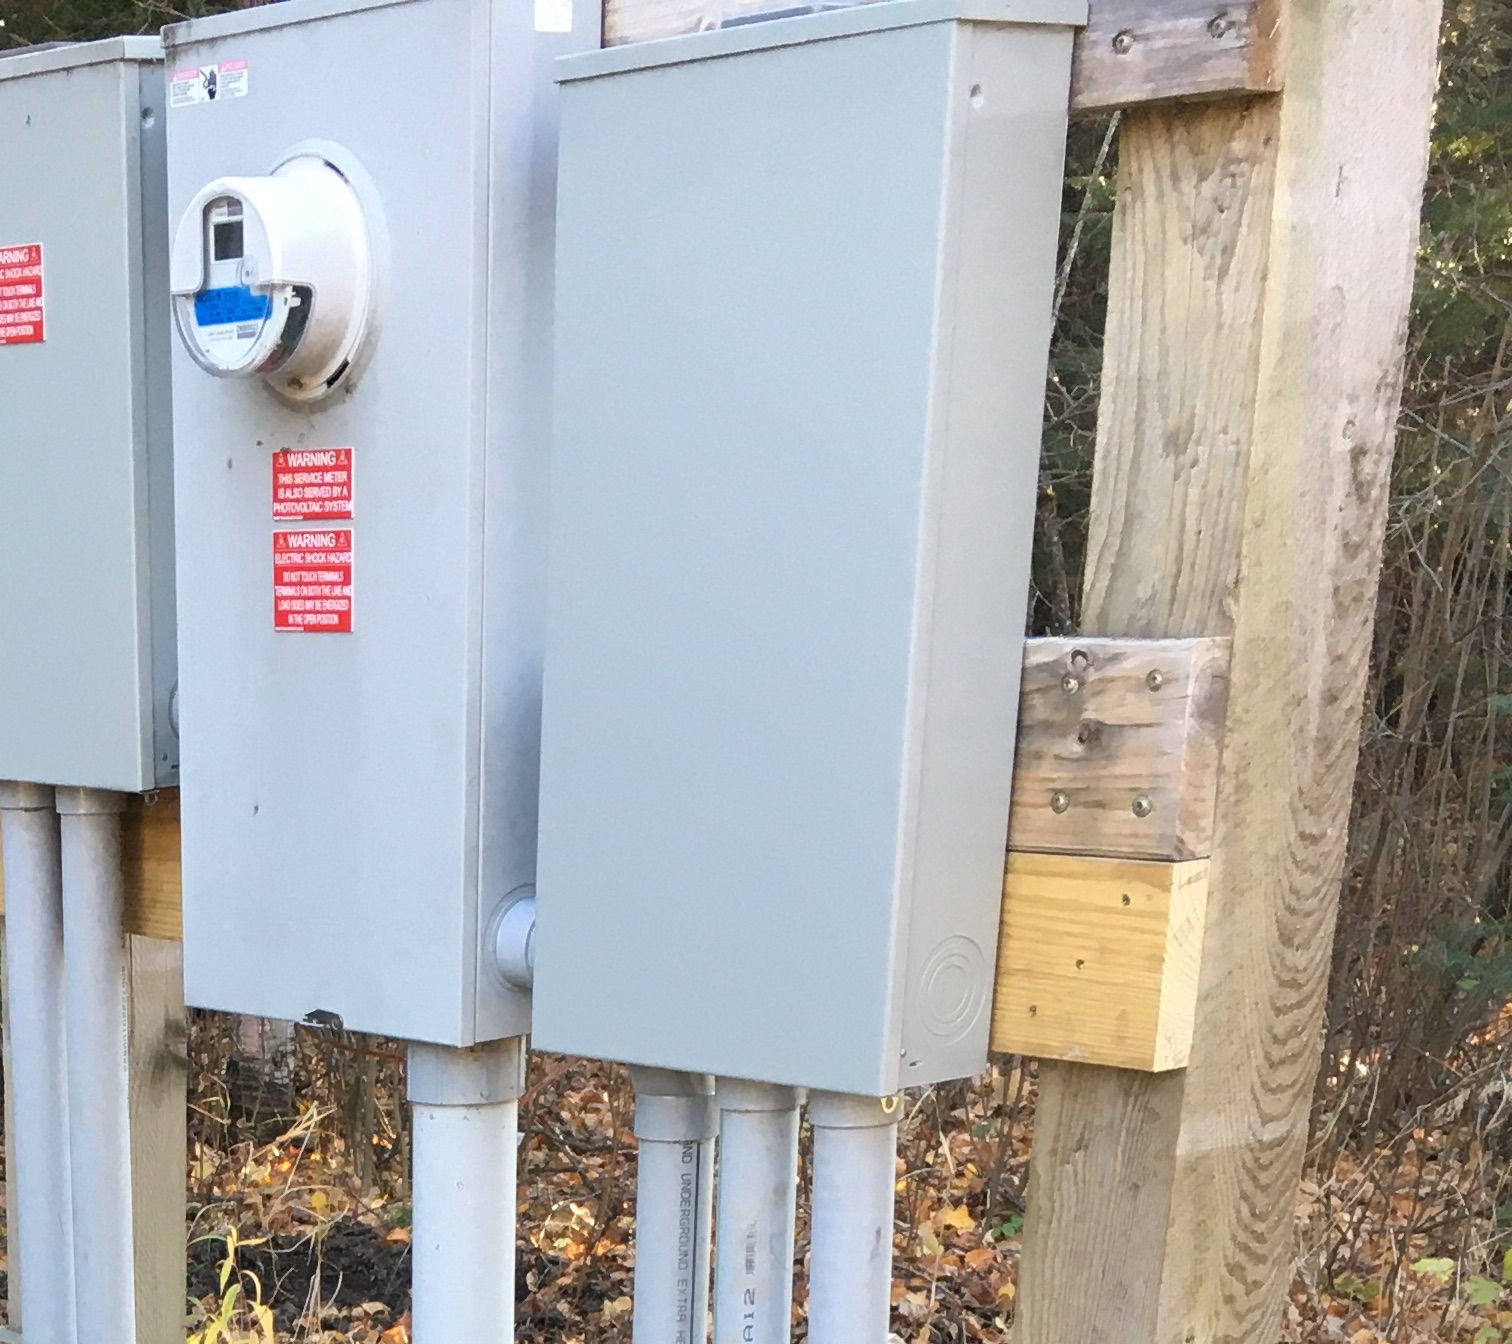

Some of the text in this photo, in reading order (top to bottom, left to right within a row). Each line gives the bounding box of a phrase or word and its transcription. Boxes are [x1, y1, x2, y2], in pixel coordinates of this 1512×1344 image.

[287, 451, 336, 467] WARNING
[278, 472, 348, 484] THIS SERVICE METER
[278, 486, 348, 499] IS ALSO SERVED BY A
[274, 500, 352, 514] PHOTOVOLTAIC SYSTEM
[287, 534, 336, 548] WARNING
[276, 552, 352, 564] ELECTRIC SHOCK HAZARD
[678, 1173, 692, 1270] UNDERGROUND
[676, 1279, 688, 1322] EXTRA
